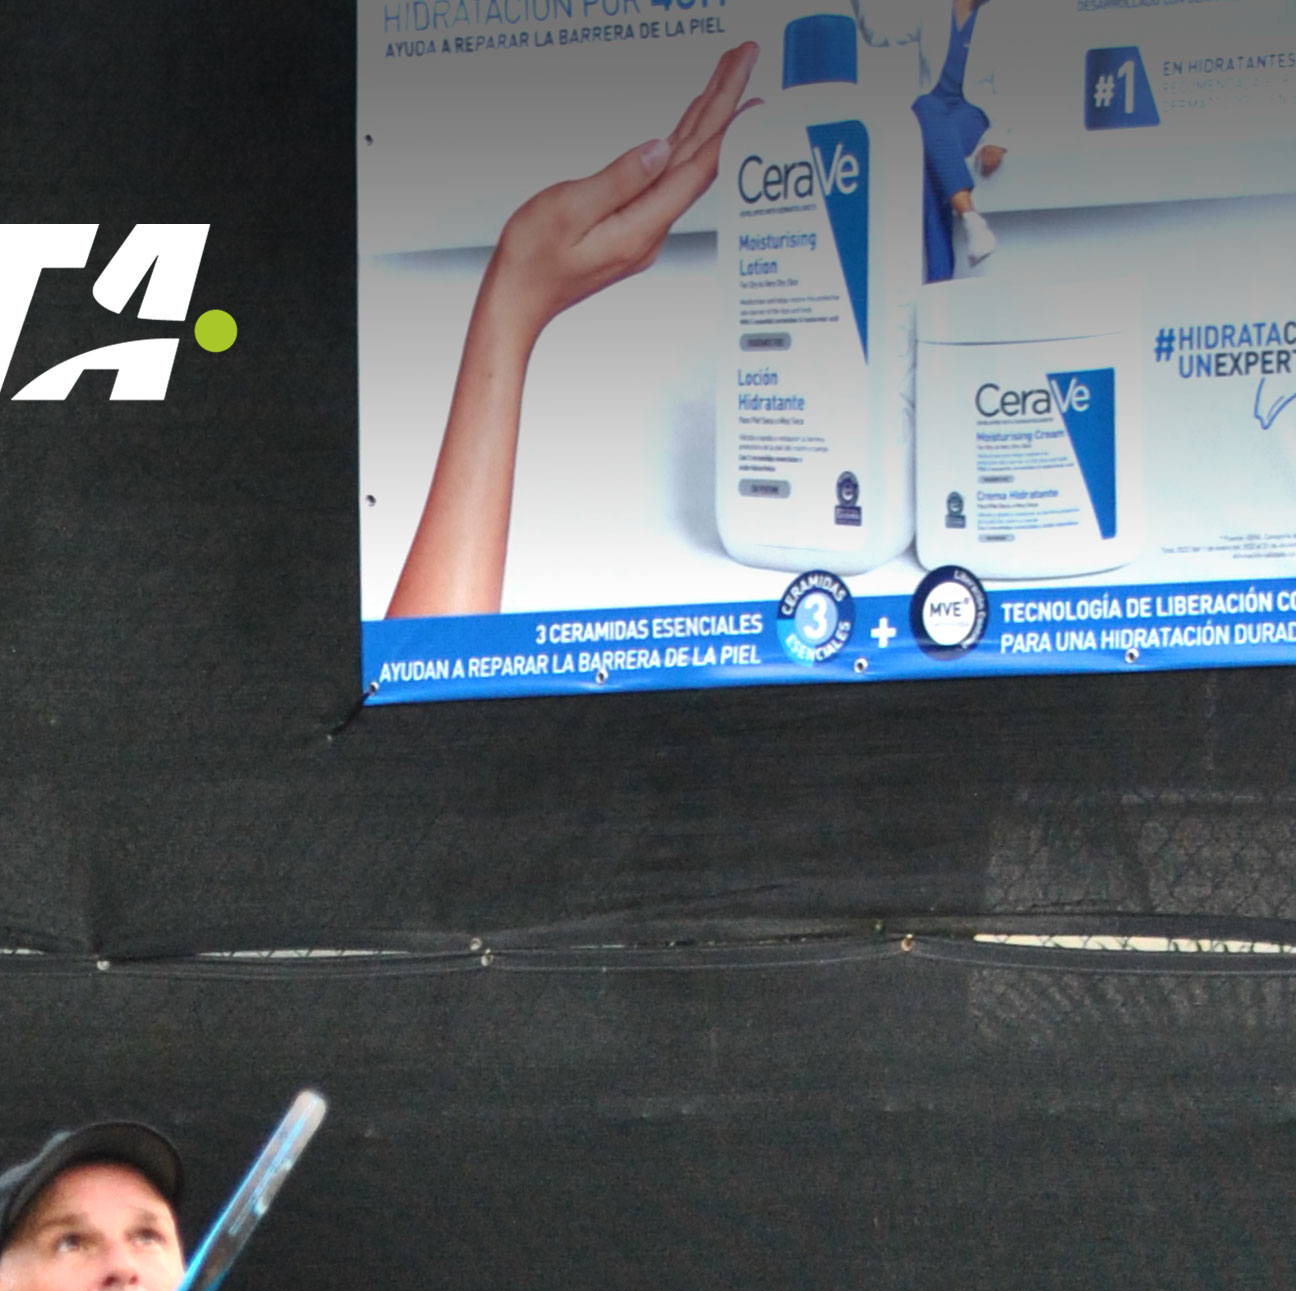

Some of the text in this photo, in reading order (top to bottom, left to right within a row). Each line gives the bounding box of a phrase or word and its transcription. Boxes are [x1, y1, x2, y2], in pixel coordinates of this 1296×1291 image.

[385, 17, 725, 58] AYUDA A REPARAR LA BARRERA DE LA PIEL
[1094, 60, 1134, 114] #1
[1164, 61, 1182, 76] EN
[738, 144, 860, 204] CeraVe
[1179, 349, 1296, 379] UNEXPER
[975, 377, 1090, 417] CeraVe
[804, 592, 827, 640] 3
[1001, 593, 1123, 623] TECNOLOGÍA
[1126, 597, 1152, 618] DE
[1156, 586, 1273, 617] LIBERACIÓN
[536, 613, 763, 645] 3 CERAMIDAS ESENCIALES
[1001, 632, 1052, 654] PARA
[1056, 630, 1097, 651] UNA
[1101, 620, 1230, 649] HIDRATACIÓN
[379, 644, 761, 683] AYUDAN A REPARAR LA BARRERA DE LA PIEL
